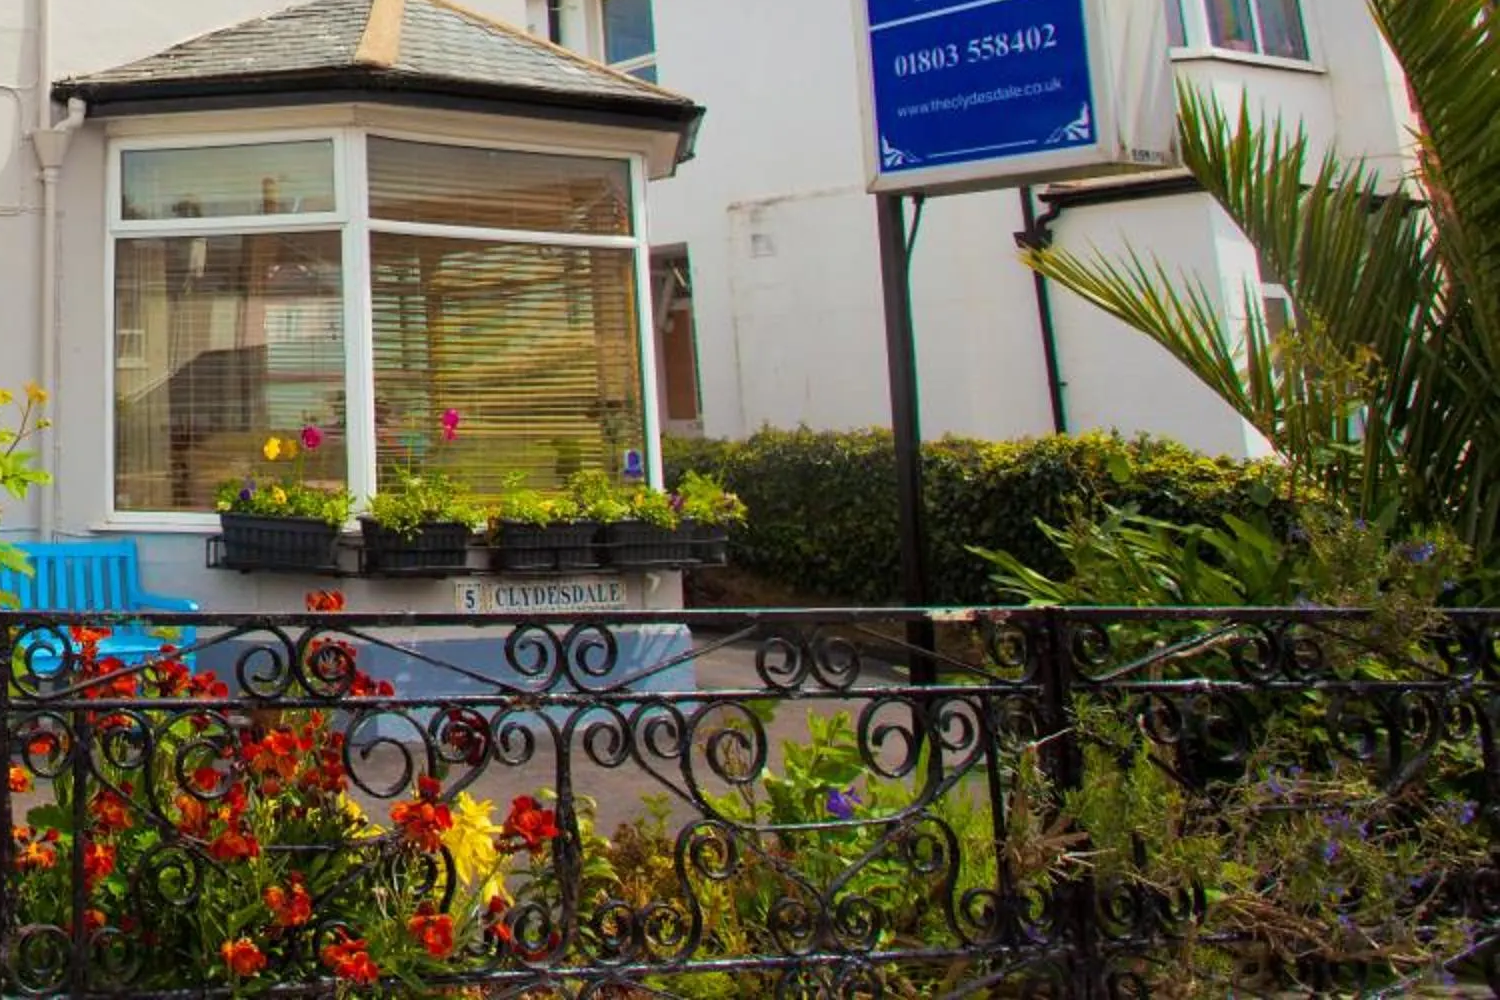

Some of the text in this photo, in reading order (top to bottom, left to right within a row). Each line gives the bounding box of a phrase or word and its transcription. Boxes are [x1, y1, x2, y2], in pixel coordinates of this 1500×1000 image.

[894, 24, 1057, 78] 01803 558402
[897, 77, 1062, 118] www.theclydesdale.co.uk
[464, 583, 621, 609] 5 CLYDESDALE
